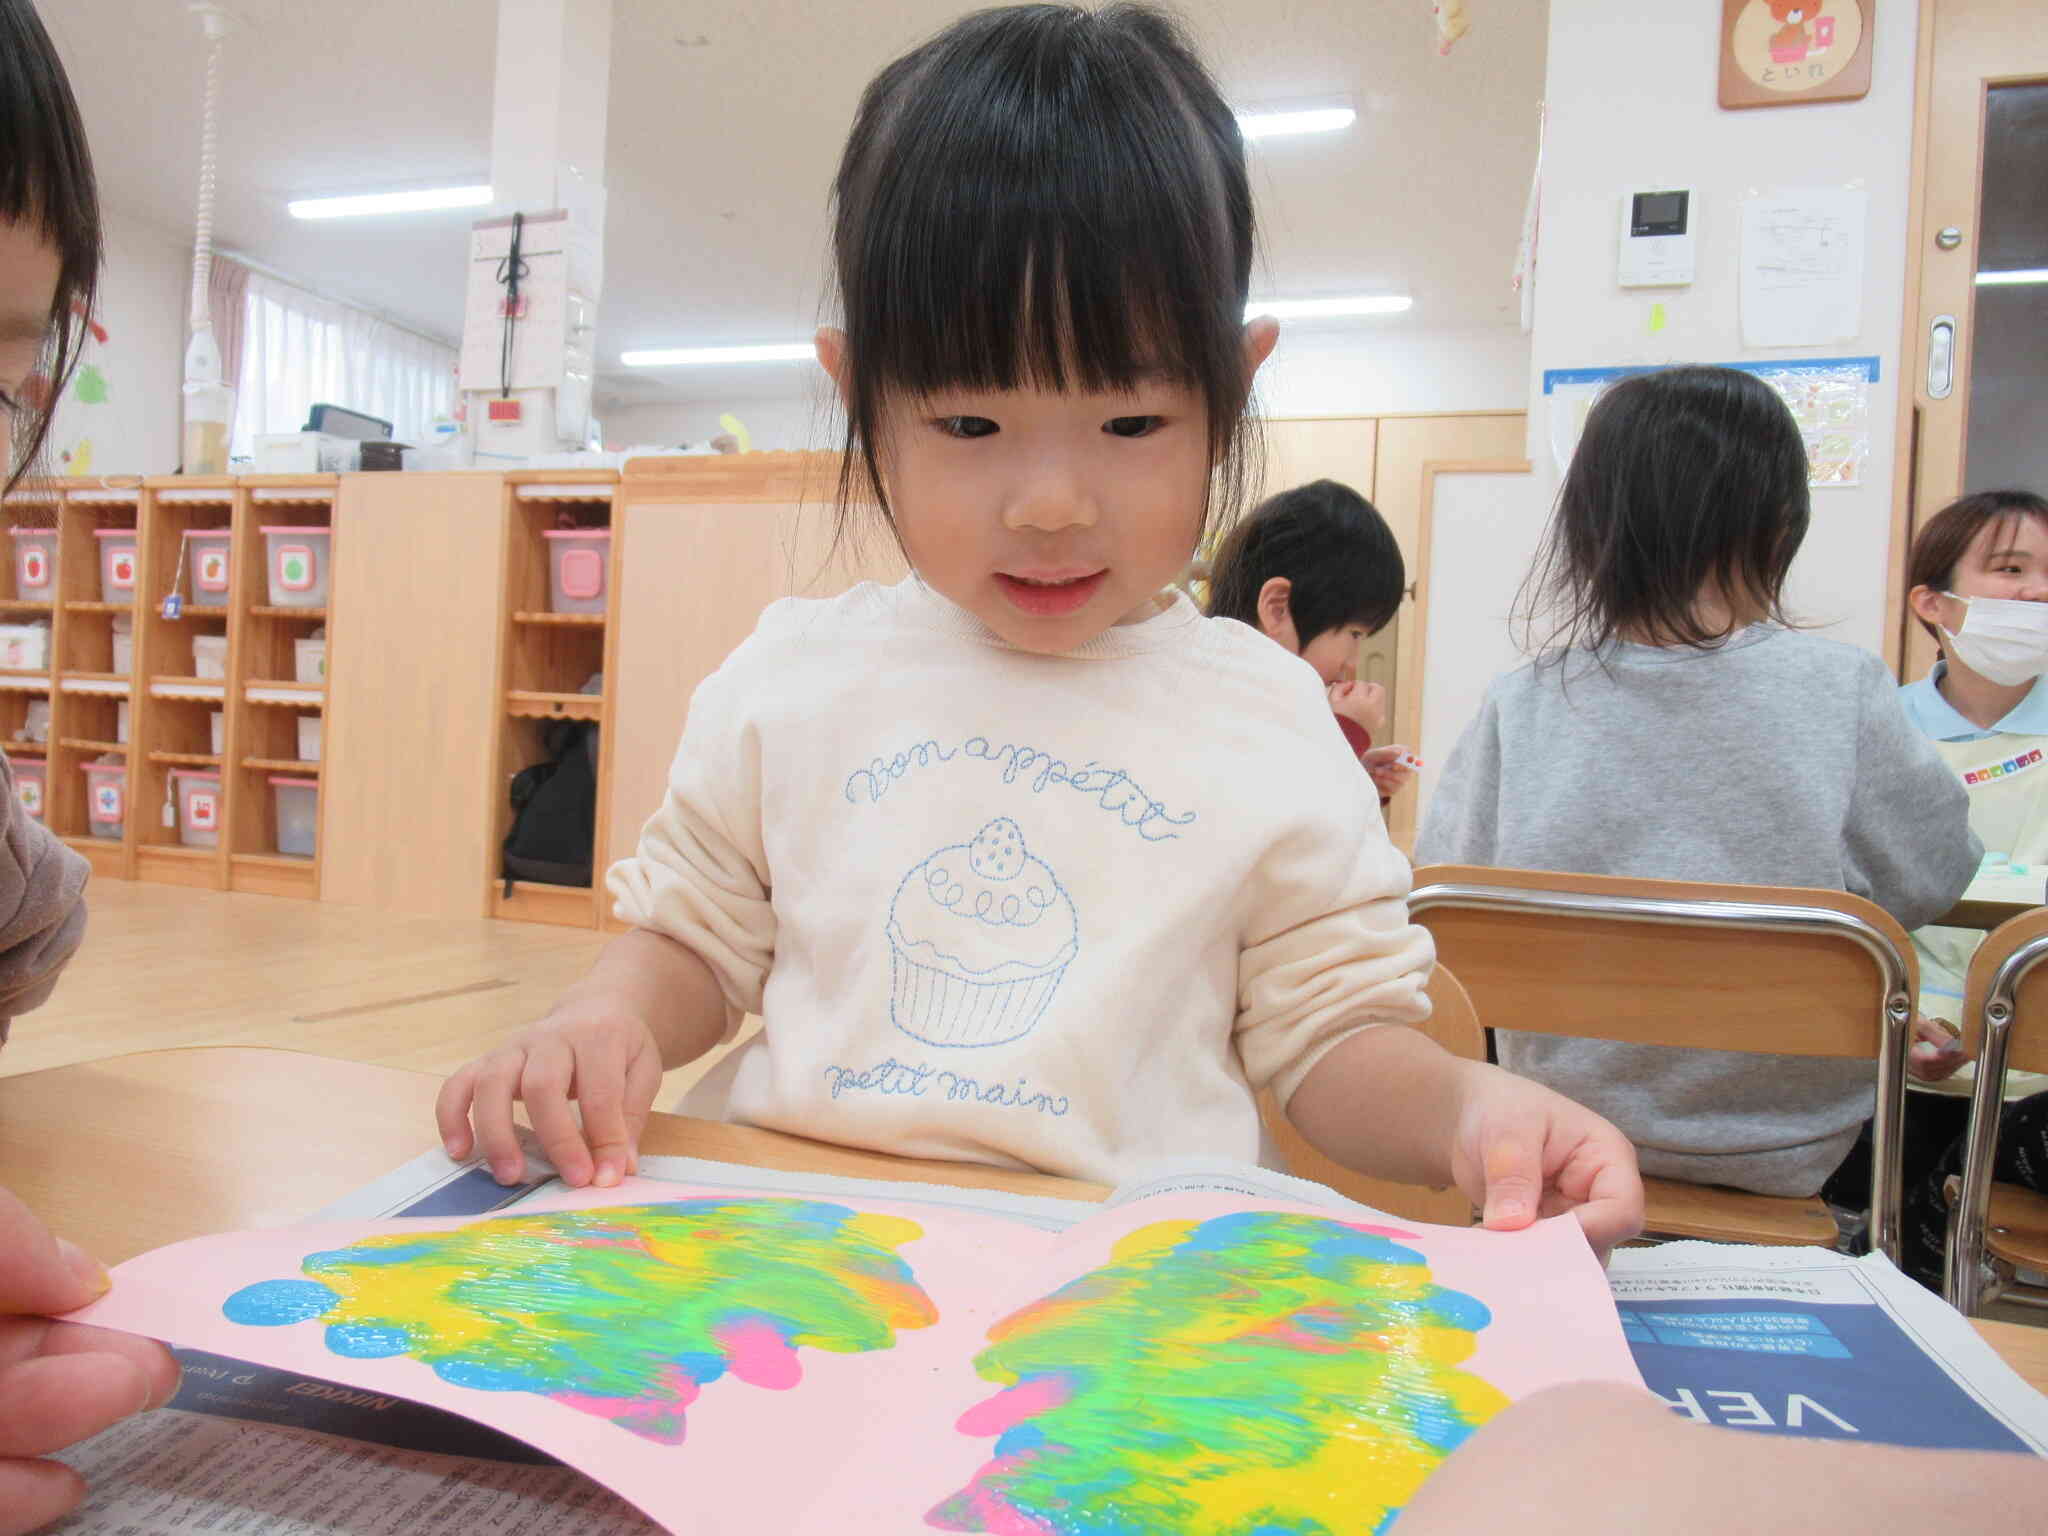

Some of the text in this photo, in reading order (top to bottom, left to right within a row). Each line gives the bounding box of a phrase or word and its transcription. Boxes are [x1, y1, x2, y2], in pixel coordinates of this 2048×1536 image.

[964, 736, 1197, 841] appétit
[824, 1057, 1069, 1117] petit main
[286, 1381, 400, 1412] NIKKEI
